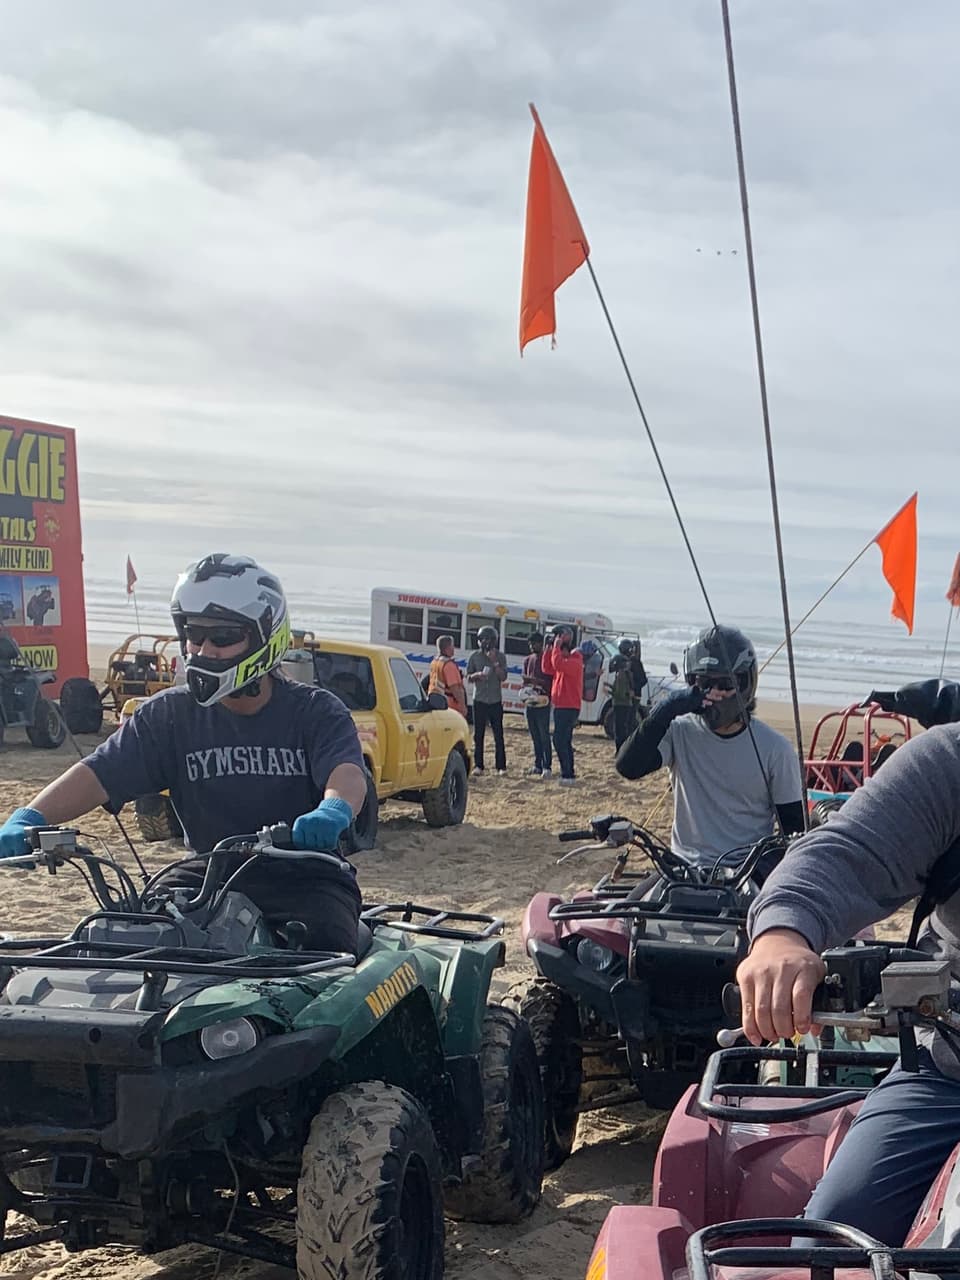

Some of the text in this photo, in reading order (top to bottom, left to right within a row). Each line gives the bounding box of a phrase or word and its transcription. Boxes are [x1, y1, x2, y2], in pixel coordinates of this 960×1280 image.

[26, 549, 49, 569] FUN!
[23, 649, 54, 668] NOW
[364, 961, 418, 1019] NARUTO
